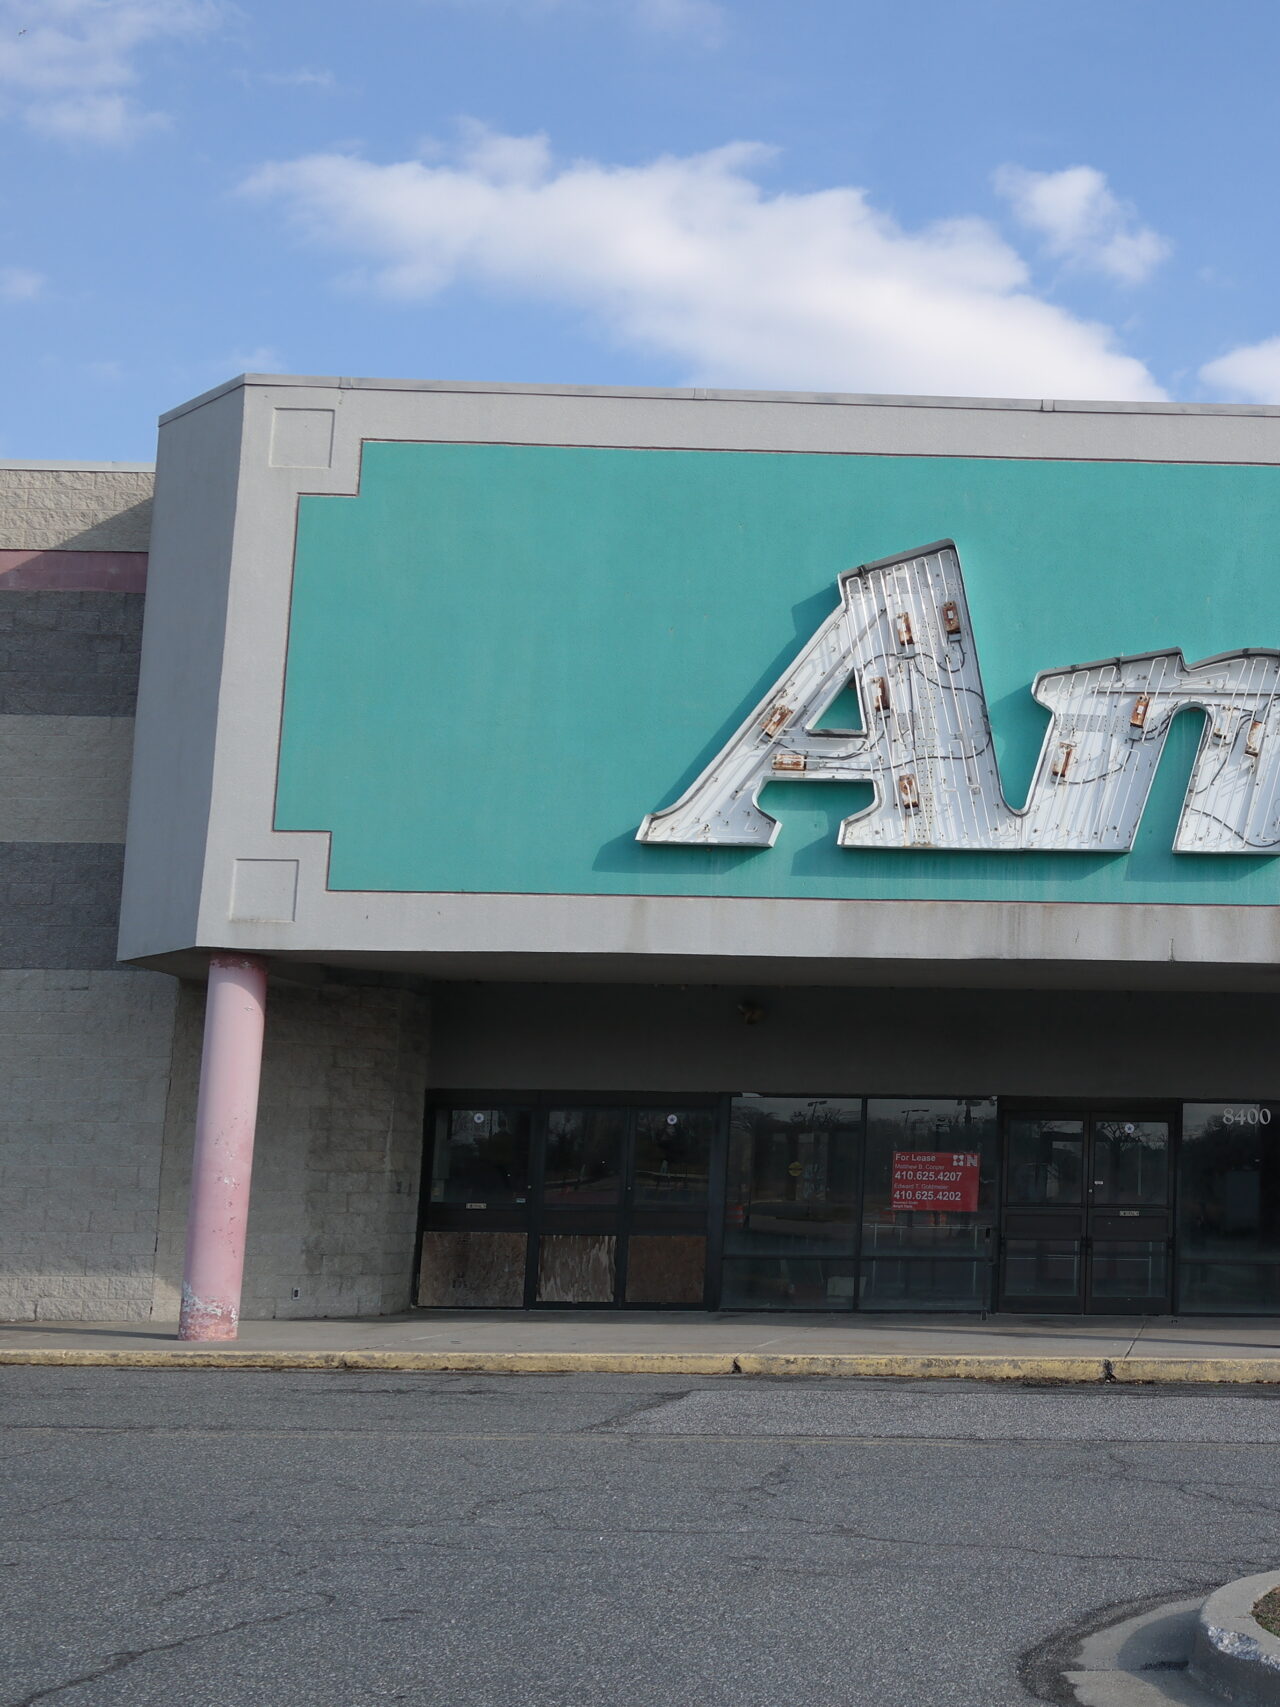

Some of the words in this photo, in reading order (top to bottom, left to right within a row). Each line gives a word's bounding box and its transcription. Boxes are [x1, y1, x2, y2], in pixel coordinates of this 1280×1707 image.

[1223, 1108, 1271, 1125] 8400
[911, 1154, 936, 1162] Lease
[895, 1171, 962, 1181] 410.625.4207
[893, 1190, 961, 1201] 410.625.4202
